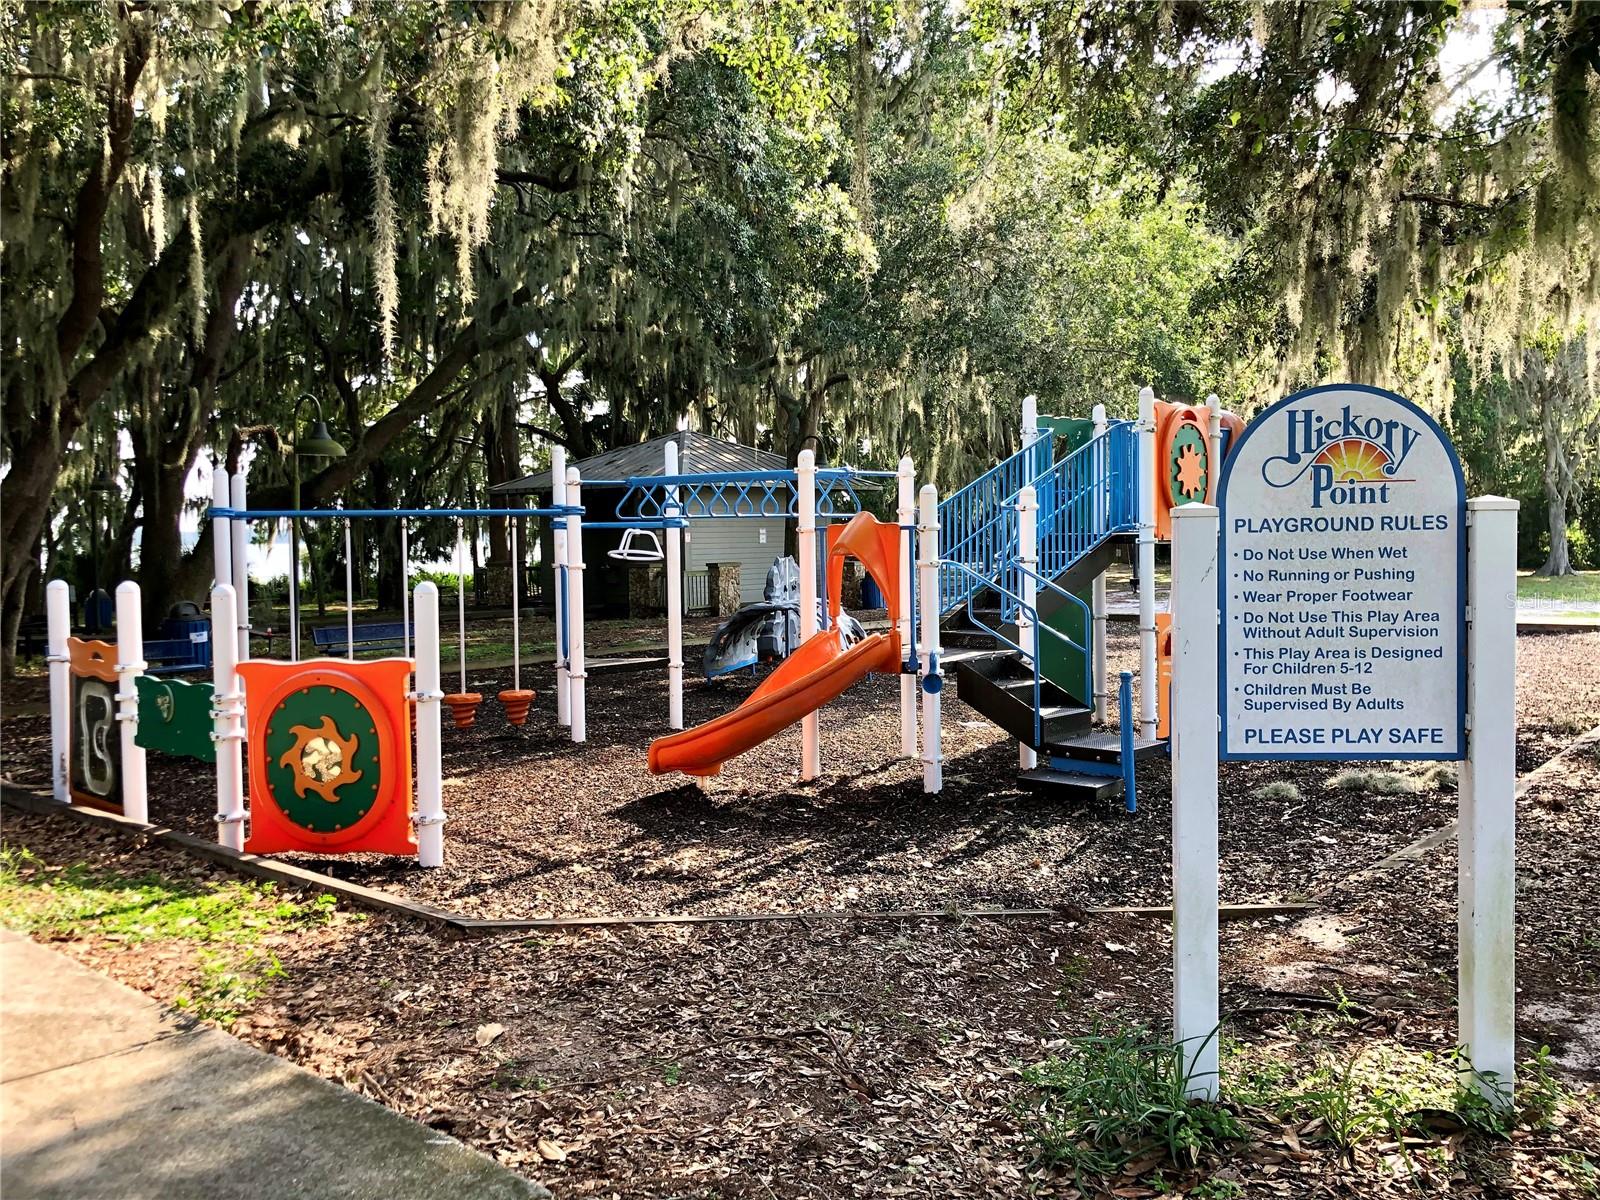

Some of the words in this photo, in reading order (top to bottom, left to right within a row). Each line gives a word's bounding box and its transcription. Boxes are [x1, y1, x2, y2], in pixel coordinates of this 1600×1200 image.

[1264, 405, 1421, 476] Hickory
[1310, 464, 1390, 508] Point
[1235, 517, 1374, 533] PLAYGROUND
[1381, 515, 1448, 531] RULES
[1244, 549, 1263, 560] Do
[1268, 549, 1294, 560] Not
[1299, 548, 1327, 559] Use
[1332, 547, 1373, 559] When
[1378, 547, 1407, 558] Wet
[1244, 570, 1263, 581] No
[1269, 569, 1329, 583] Running
[1334, 572, 1349, 580] or
[1355, 568, 1414, 582] Pushing
[1243, 591, 1282, 602] Wear
[1287, 591, 1337, 604] Proper
[1343, 590, 1413, 601] Footwear
[1244, 612, 1263, 623] Do
[1269, 612, 1294, 623] Not
[1299, 611, 1327, 623] Use
[1331, 611, 1362, 622] This
[1368, 611, 1399, 625] Play
[1404, 610, 1439, 622] Area
[1243, 627, 1301, 638] Without
[1305, 626, 1345, 638] Adult
[1349, 625, 1438, 640] Supervision
[1243, 648, 1274, 659] This
[1279, 648, 1310, 662] Play
[1315, 648, 1350, 659] Area
[1355, 647, 1366, 658] is
[1372, 646, 1442, 661] Designed
[1244, 663, 1268, 674] For
[1273, 662, 1335, 674] Children
[1341, 662, 1372, 673] 5-12
[1244, 684, 1306, 695] Children
[1312, 683, 1347, 695] Must
[1352, 683, 1371, 694] Be
[1244, 699, 1327, 713] Supervised
[1333, 698, 1351, 713] By
[1356, 698, 1404, 709] Adults
[1245, 729, 1325, 744] PLEASE
[1332, 728, 1383, 743] PLAY
[1389, 728, 1443, 743] SAFE
